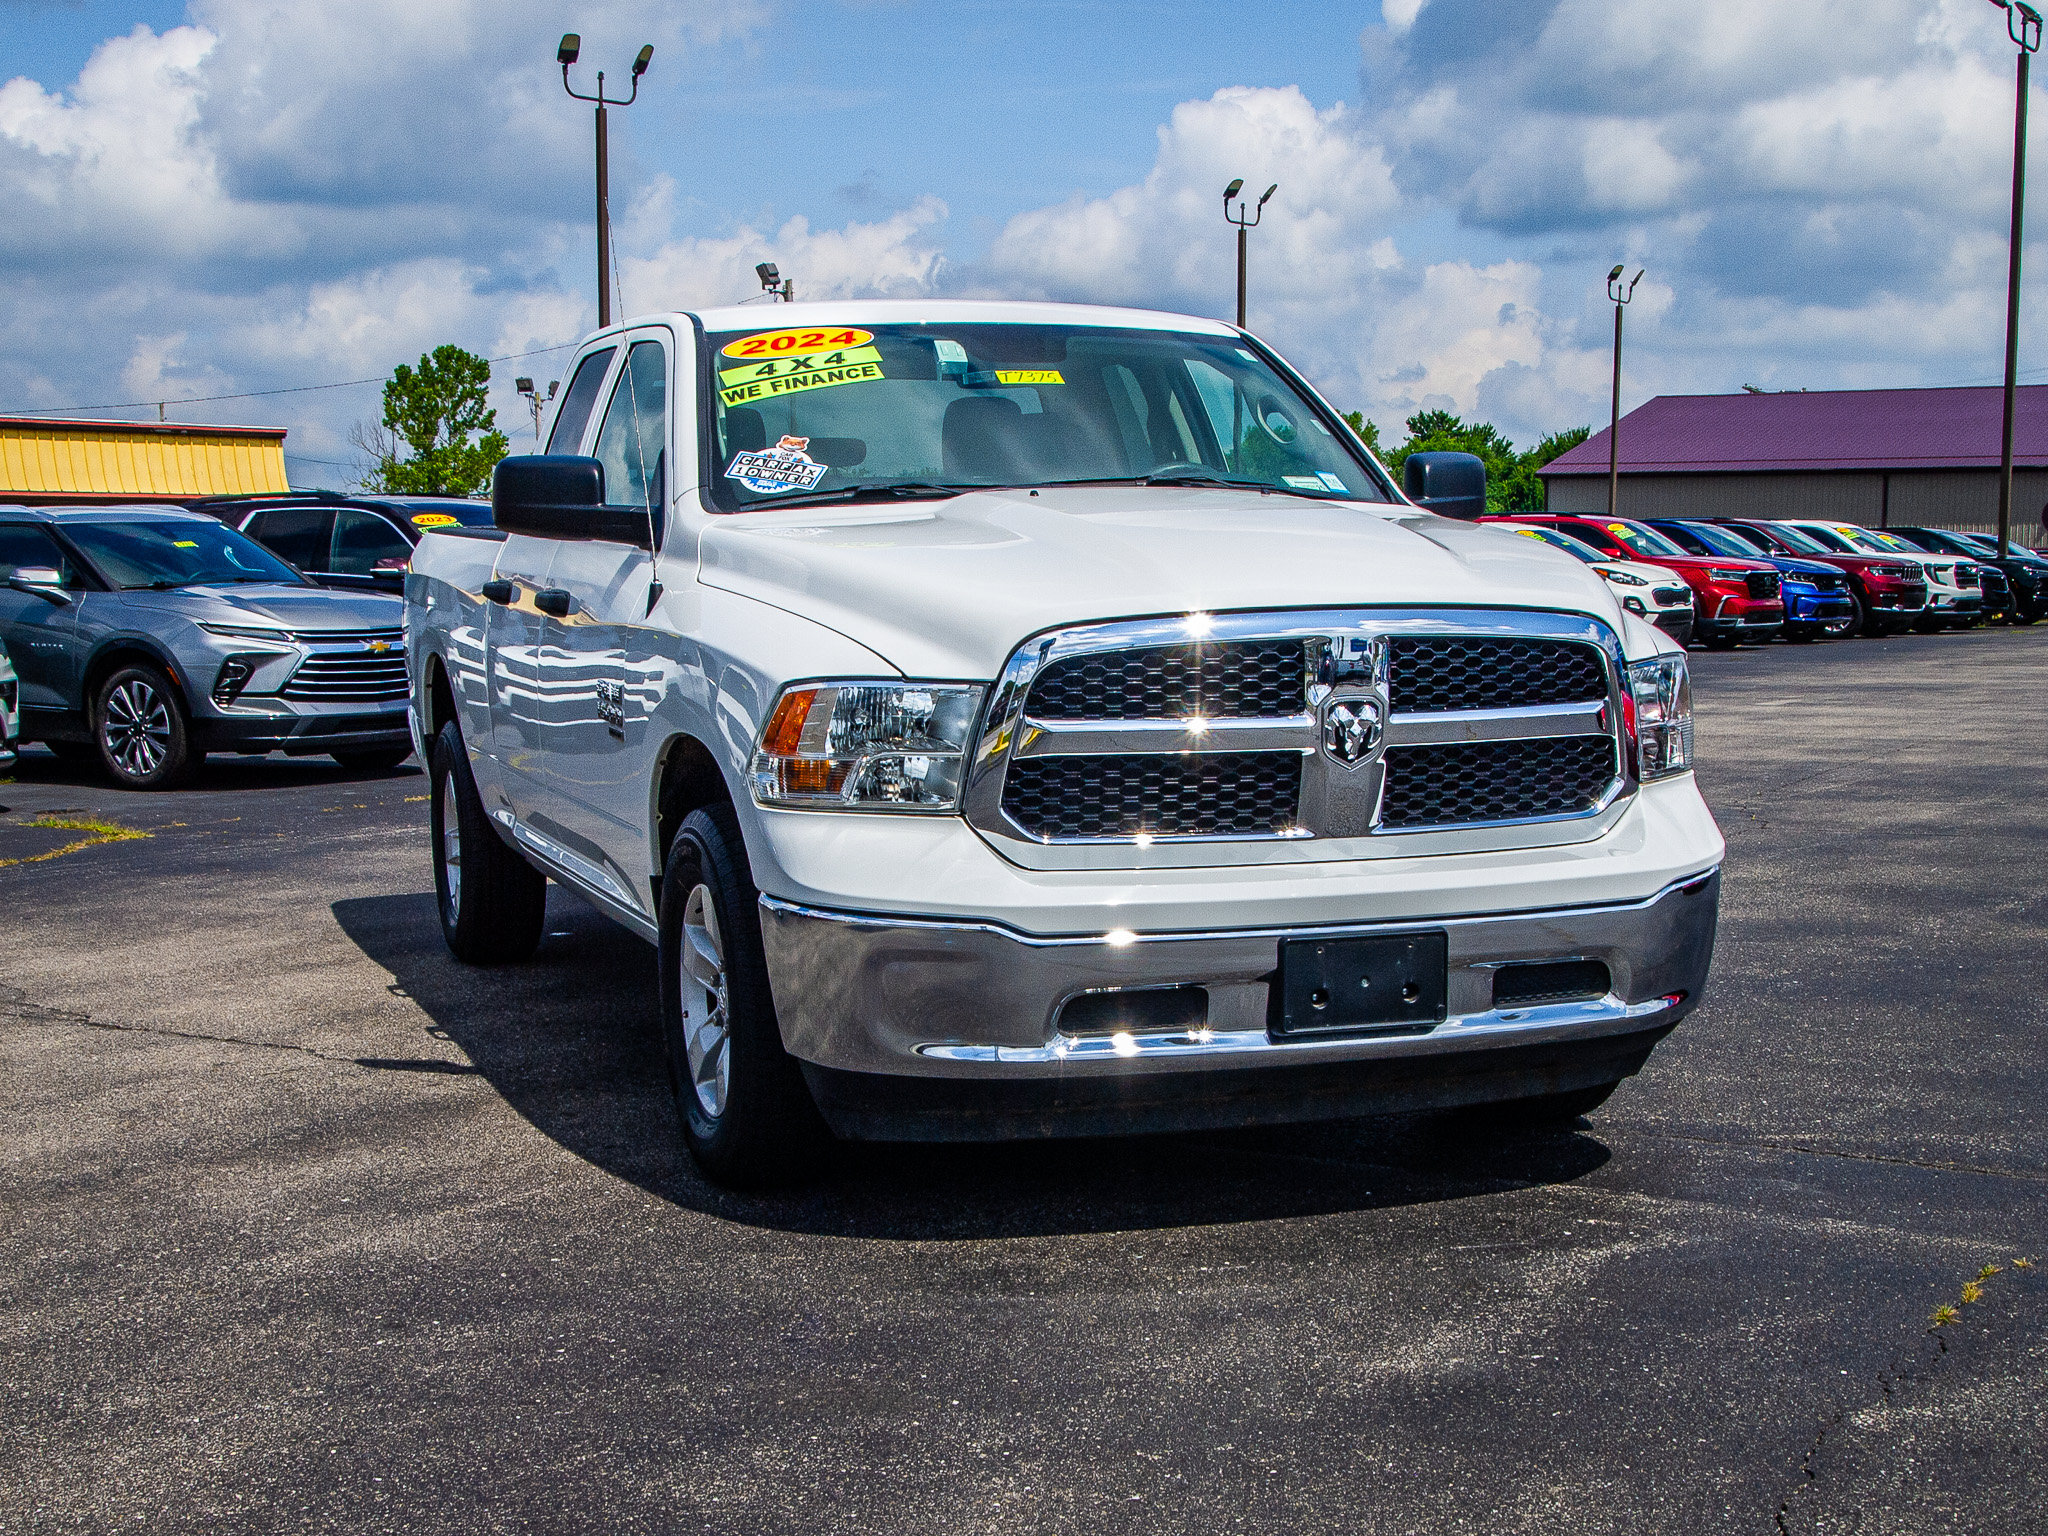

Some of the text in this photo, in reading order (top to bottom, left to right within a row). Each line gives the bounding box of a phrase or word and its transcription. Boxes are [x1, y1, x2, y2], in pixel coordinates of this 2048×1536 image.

[739, 331, 857, 356] 2024
[755, 362, 777, 377] 4
[824, 351, 846, 365] 4
[724, 365, 876, 403] WE FINANCE
[739, 455, 818, 477] CARFAX
[746, 466, 815, 486] OWNER
[417, 516, 452, 524] 2023
